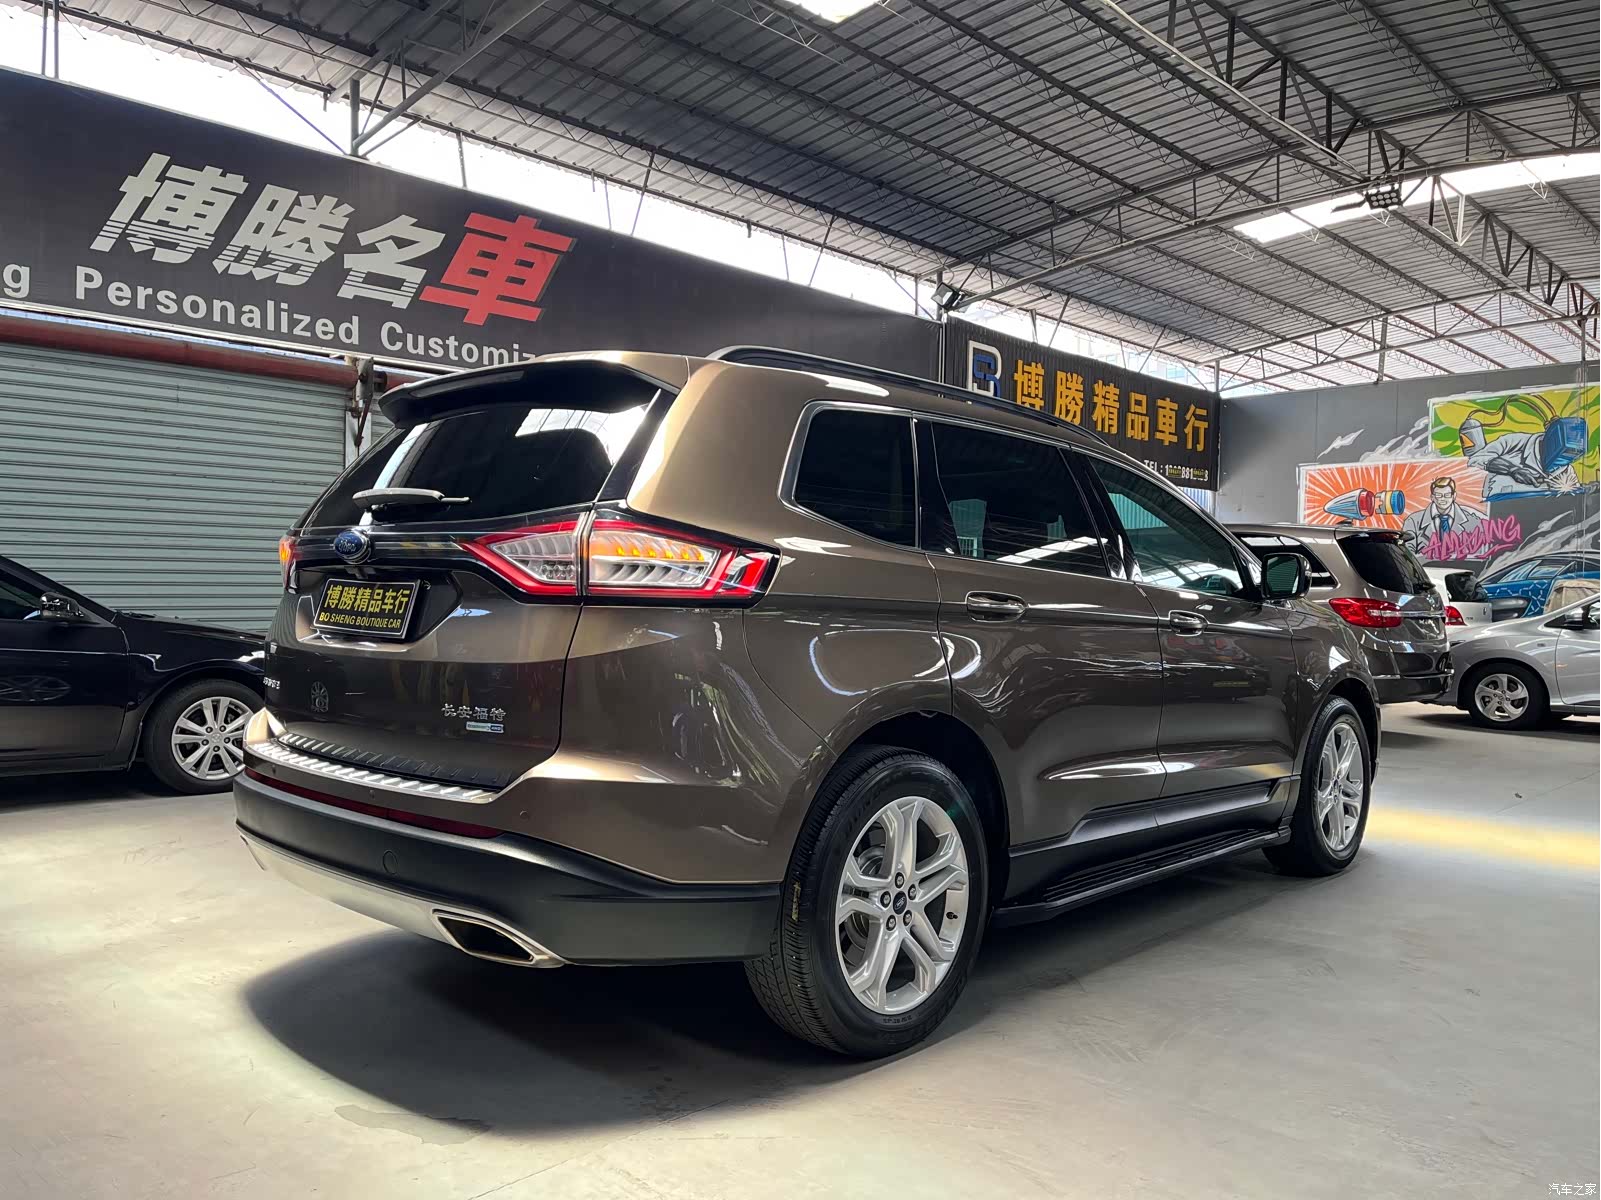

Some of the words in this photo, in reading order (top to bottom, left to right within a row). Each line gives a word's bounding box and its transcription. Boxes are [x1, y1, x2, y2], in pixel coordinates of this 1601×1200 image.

[90, 152, 577, 326] 博勝名車
[76, 265, 359, 345] Personalized
[381, 321, 536, 366] Customi
[1013, 359, 1208, 451] 博勝精品車行
[1421, 514, 1522, 560] AMAZING
[319, 612, 330, 621] BO
[330, 613, 355, 625] SHENG
[355, 616, 388, 628] BOUTIQUE
[388, 619, 401, 628] CAR
[324, 584, 410, 614] 博勝精品车行
[441, 703, 506, 721] 长安福特
